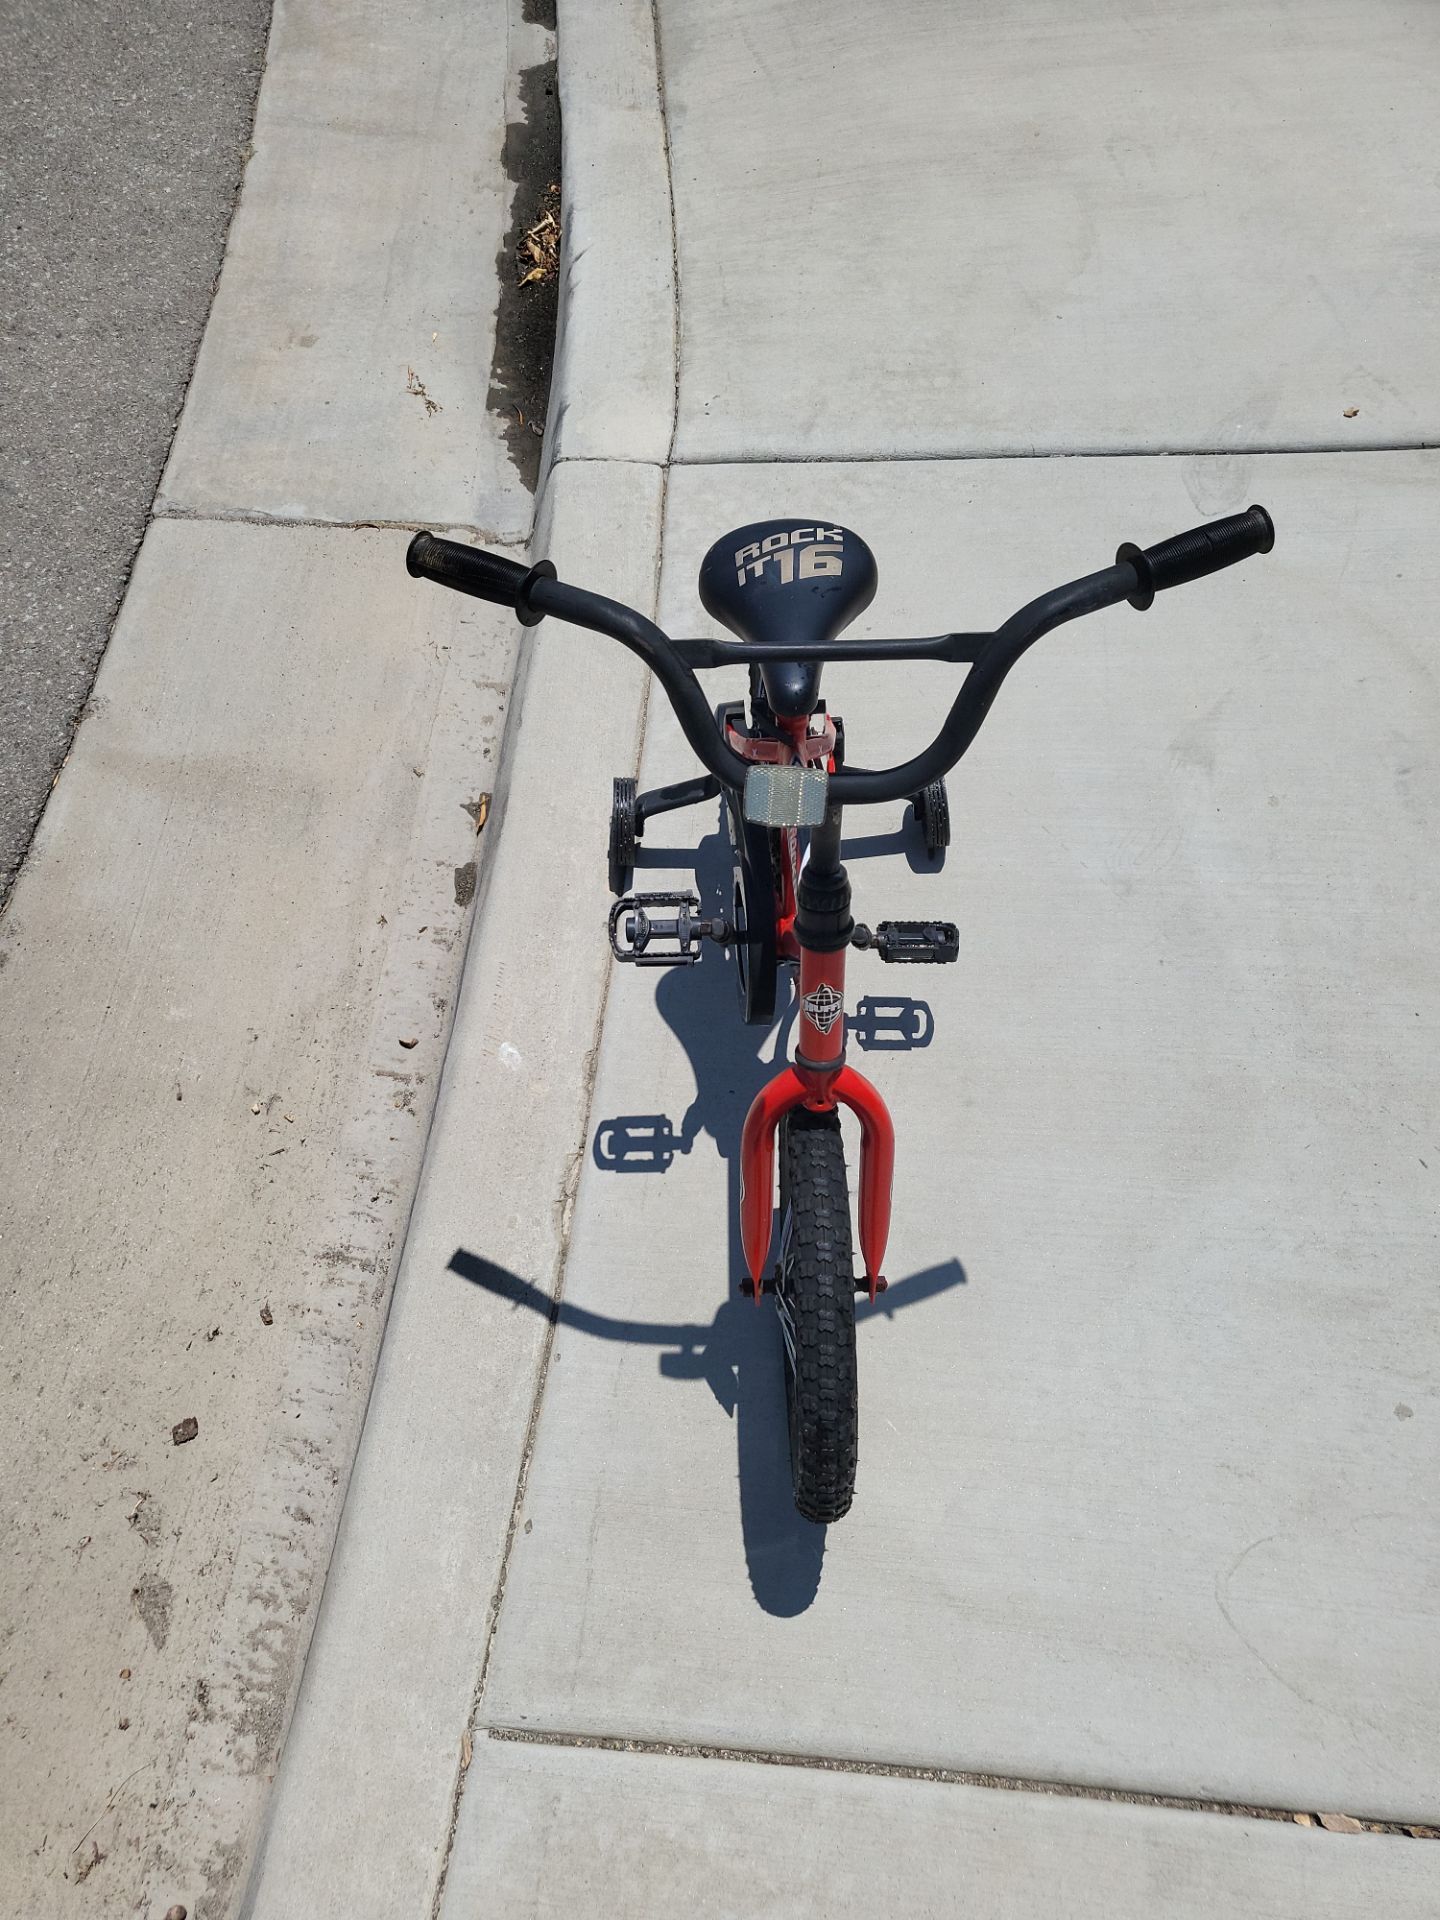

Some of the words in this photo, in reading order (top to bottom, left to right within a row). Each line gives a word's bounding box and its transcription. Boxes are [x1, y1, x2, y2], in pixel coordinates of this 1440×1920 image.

[735, 528, 843, 567] ROCK
[737, 555, 772, 587] IT
[773, 543, 844, 585] 16
